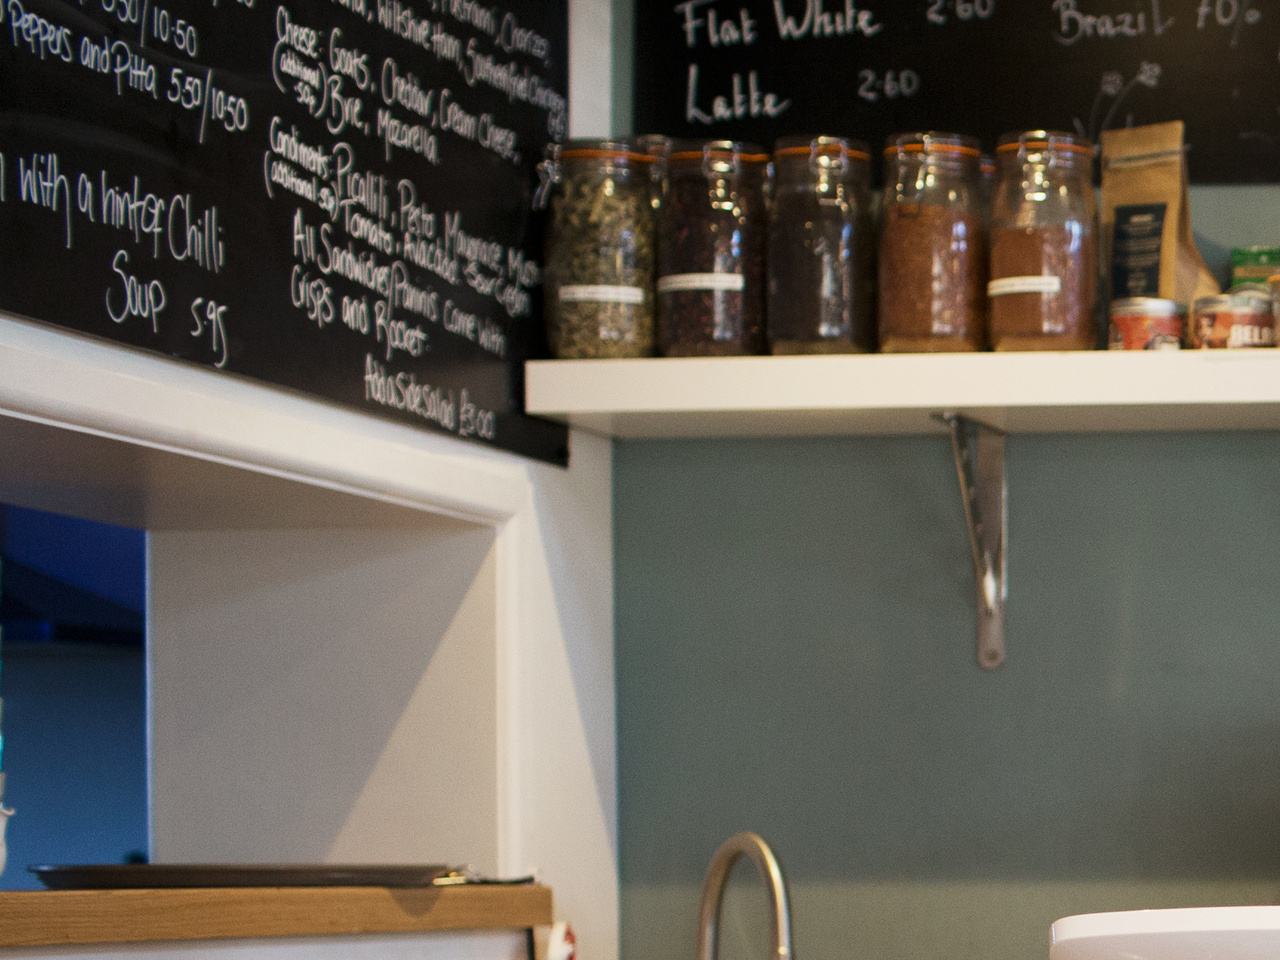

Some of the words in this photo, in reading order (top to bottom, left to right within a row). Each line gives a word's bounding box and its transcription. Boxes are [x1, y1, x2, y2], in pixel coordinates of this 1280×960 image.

[7, 0, 73, 63] Peppers
[80, 35, 110, 74] and
[675, 0, 758, 48] Flat
[773, 0, 885, 41] White
[1055, 0, 1177, 45] Brazil
[685, 63, 792, 124] Latte
[77, 171, 95, 223] a
[167, 193, 226, 274] Chilli
[293, 206, 317, 264] All
[105, 248, 167, 334] Soup
[291, 263, 335, 330] Crisps
[342, 295, 370, 335] and
